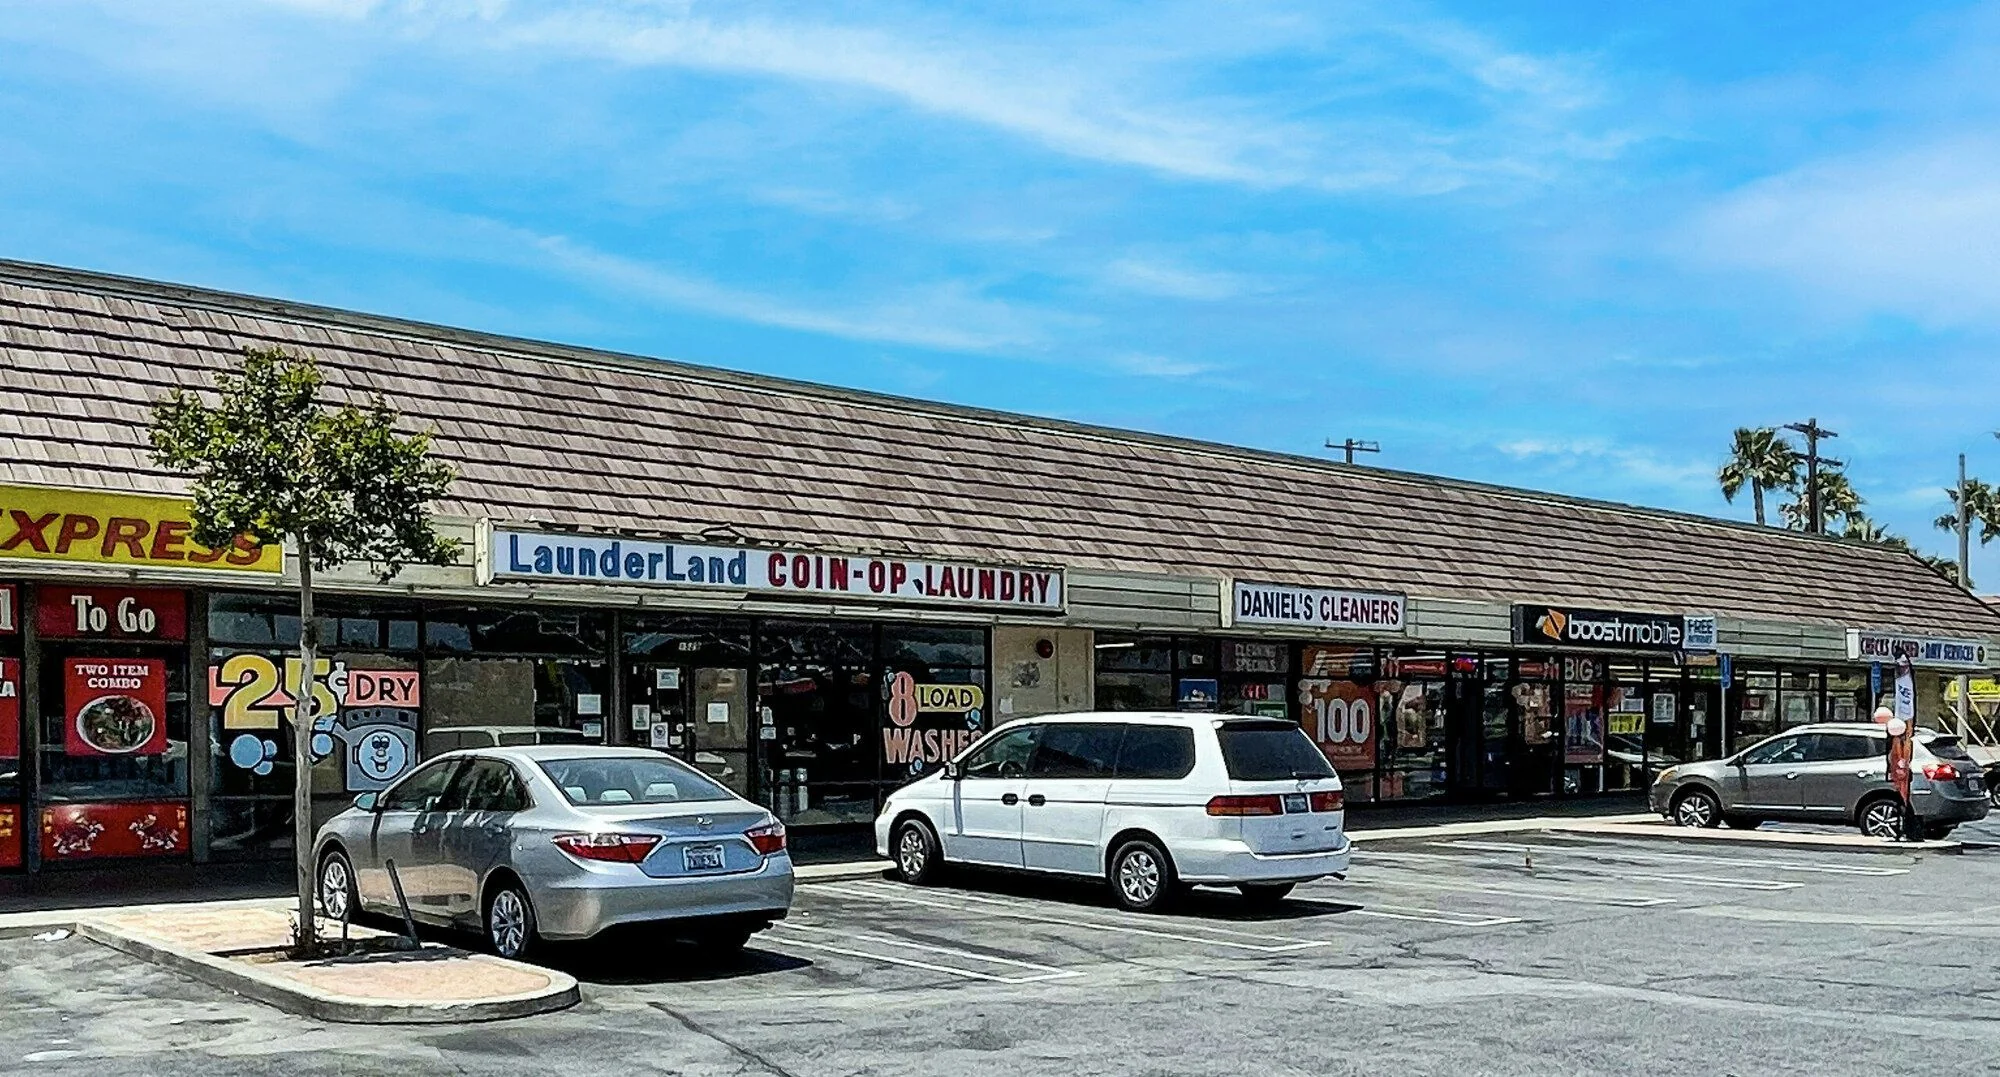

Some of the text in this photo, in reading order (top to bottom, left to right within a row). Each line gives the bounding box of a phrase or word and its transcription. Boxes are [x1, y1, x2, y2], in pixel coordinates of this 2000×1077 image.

[509, 534, 1050, 604] LaunderLand COIN-OP LAUNDRY
[71, 595, 155, 632] To Go
[1241, 590, 1399, 625] DANIEL'S CLEANERS
[1688, 619, 1713, 634] FREE
[75, 664, 149, 676] TWO ITEM
[1235, 658, 1276, 672] SPECIALS
[1564, 657, 1593, 681] BIG
[87, 678, 141, 689] COMBO
[355, 674, 415, 701] DRY
[889, 671, 973, 726] 8 LOAD
